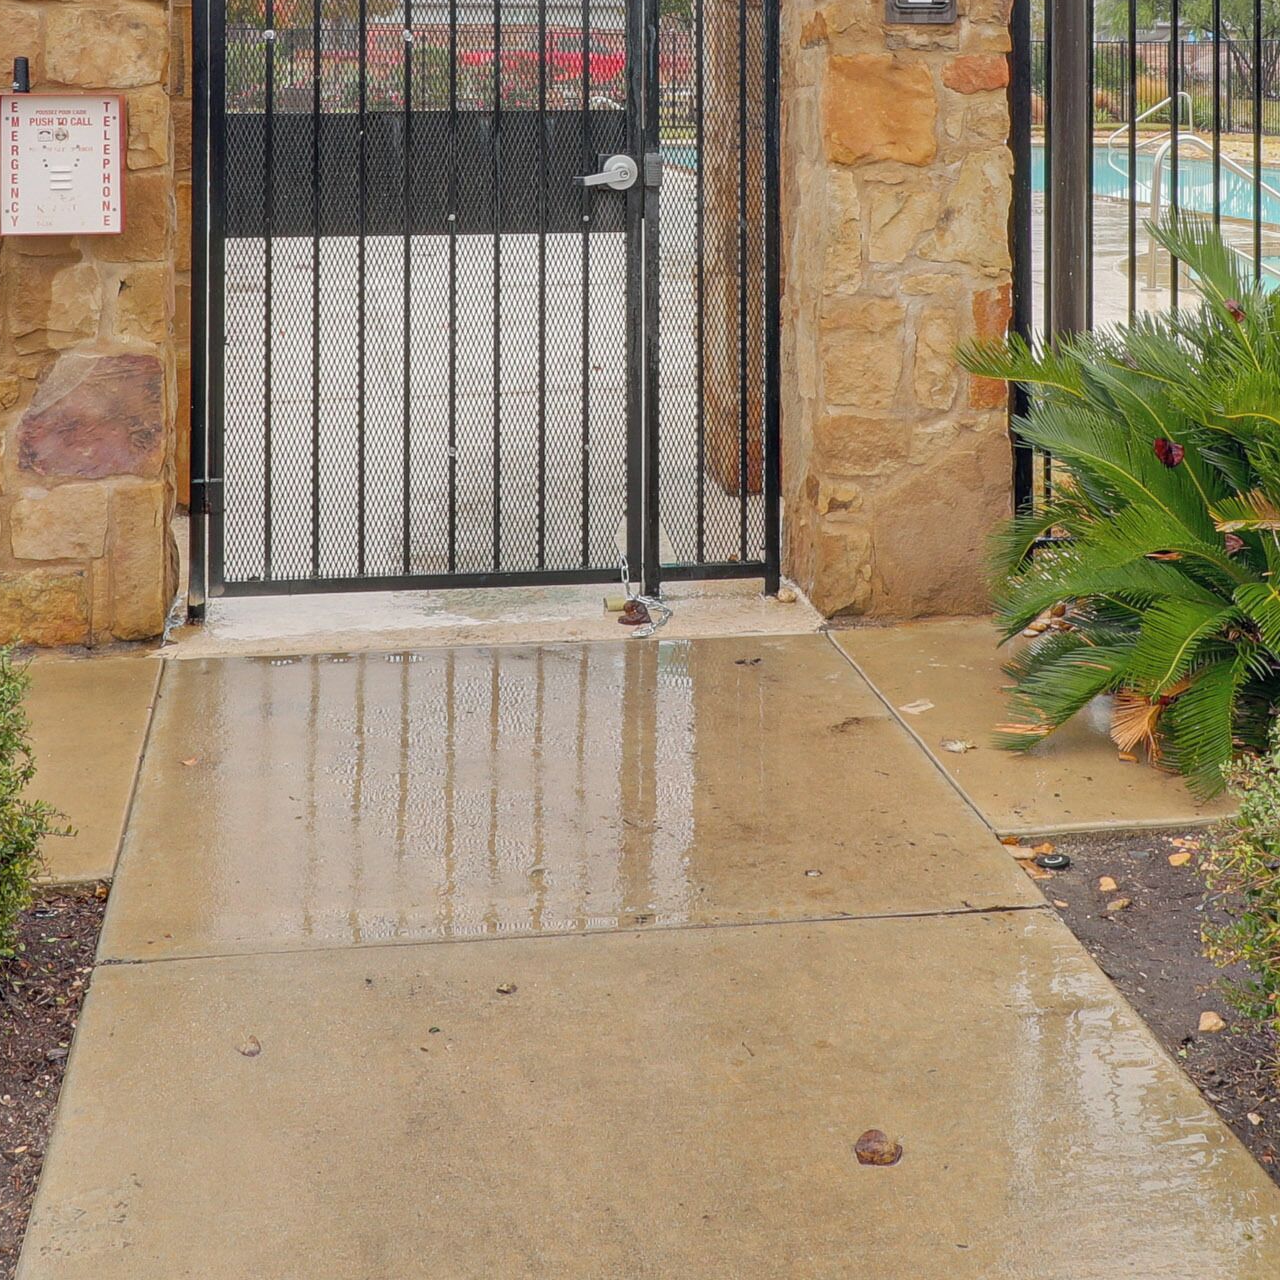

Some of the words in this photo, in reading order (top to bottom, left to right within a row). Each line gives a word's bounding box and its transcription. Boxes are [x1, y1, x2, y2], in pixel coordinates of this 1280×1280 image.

[11, 101, 19, 227] EMERGENCY
[29, 117, 54, 126] PUSH
[56, 117, 68, 126] TO
[70, 117, 93, 126] CALL
[103, 101, 111, 226] TELEPHONE
